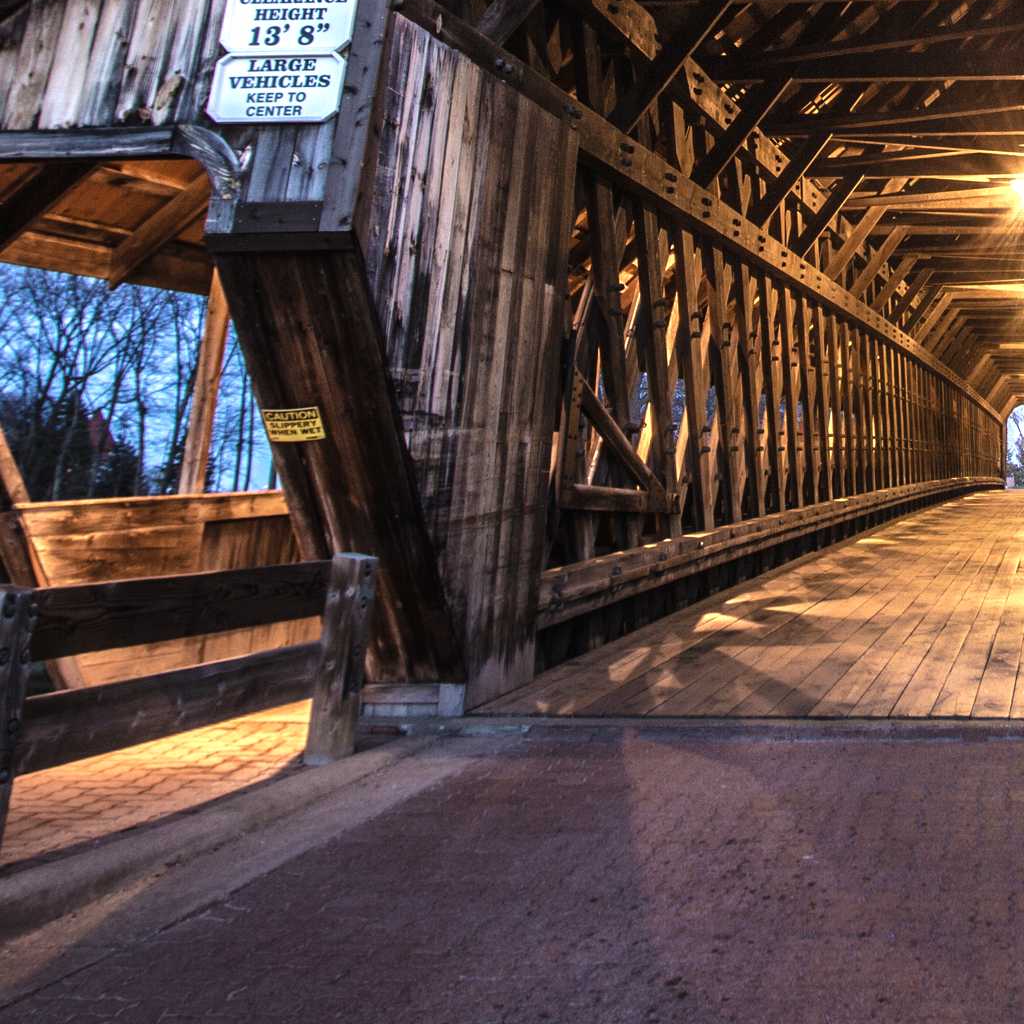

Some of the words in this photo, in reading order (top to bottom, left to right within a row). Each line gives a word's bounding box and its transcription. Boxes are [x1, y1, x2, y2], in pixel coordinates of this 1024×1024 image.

[254, 8, 327, 20] HEIGHT
[248, 59, 316, 72] LARGE
[229, 75, 331, 89] VEHICLES
[246, 93, 284, 103] KEEP
[288, 92, 306, 102] TO
[246, 106, 302, 116] CENTER
[265, 409, 318, 420] CAUTION
